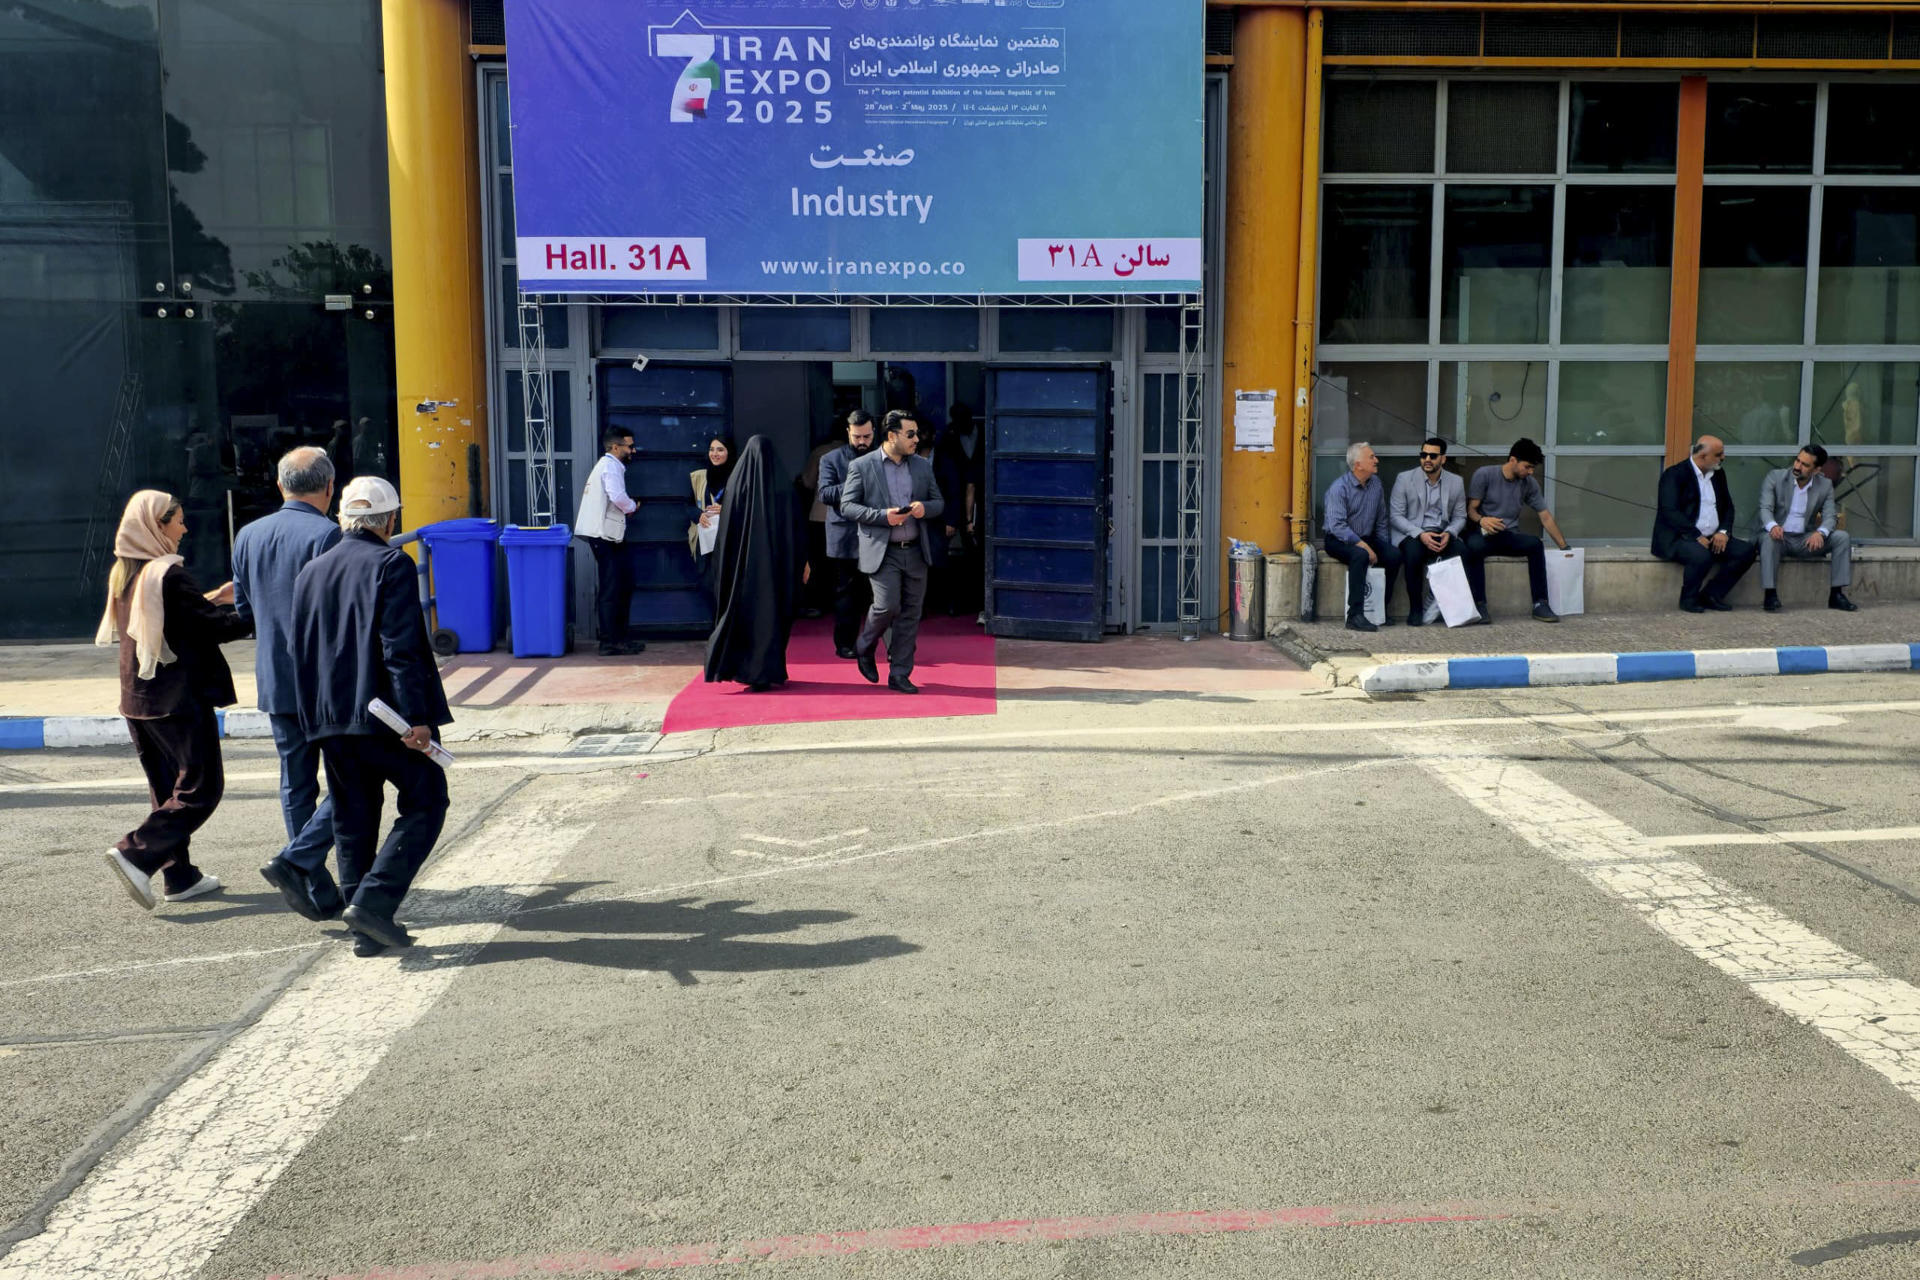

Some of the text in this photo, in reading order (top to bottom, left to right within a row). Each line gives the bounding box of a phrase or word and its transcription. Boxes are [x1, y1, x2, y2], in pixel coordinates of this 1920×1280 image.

[723, 36, 832, 62] IRAN
[939, 32, 999, 52] نمایشگاه
[1007, 34, 1060, 52] هفتمین
[724, 68, 832, 95] EXPO
[849, 60, 1060, 79] صادراتی جمهوری اسلامی ایران
[858, 88, 869, 96] The
[881, 88, 900, 97] Export
[963, 88, 970, 96] of
[973, 88, 982, 96] the
[725, 99, 833, 125] 2025
[928, 103, 949, 111] 2025
[810, 144, 915, 169] صنعت
[791, 186, 934, 225] Industry
[545, 243, 692, 271] Hall. 31A
[760, 257, 966, 280] www.iranexpo.co
[1113, 243, 1171, 277] سالن
